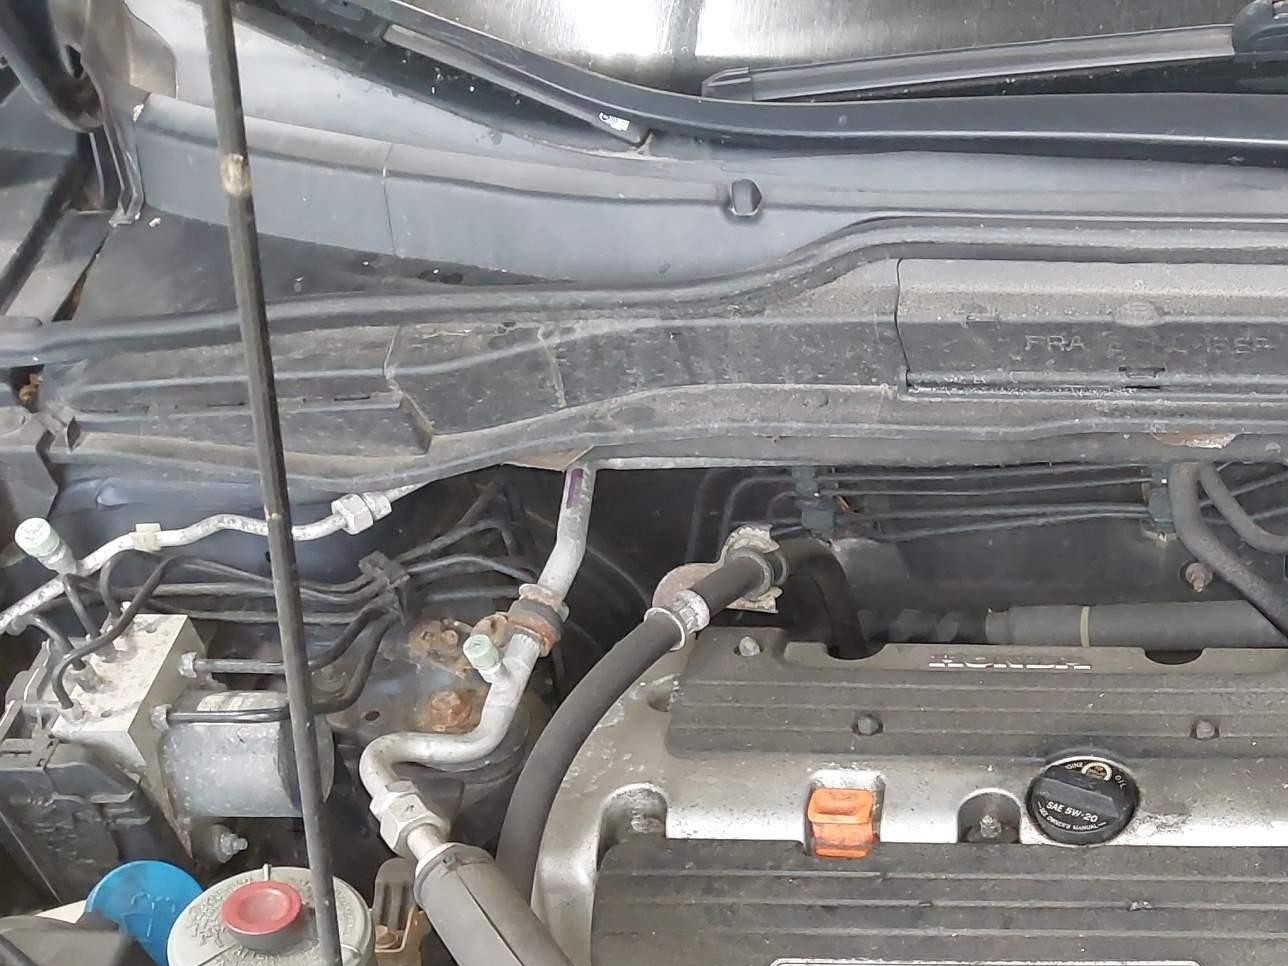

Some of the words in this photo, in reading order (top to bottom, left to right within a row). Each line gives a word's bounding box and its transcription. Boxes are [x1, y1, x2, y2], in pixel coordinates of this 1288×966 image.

[1046, 801, 1065, 813] SAE
[1064, 806, 1098, 823] 5W-20
[1072, 822, 1100, 831] MANUAL
